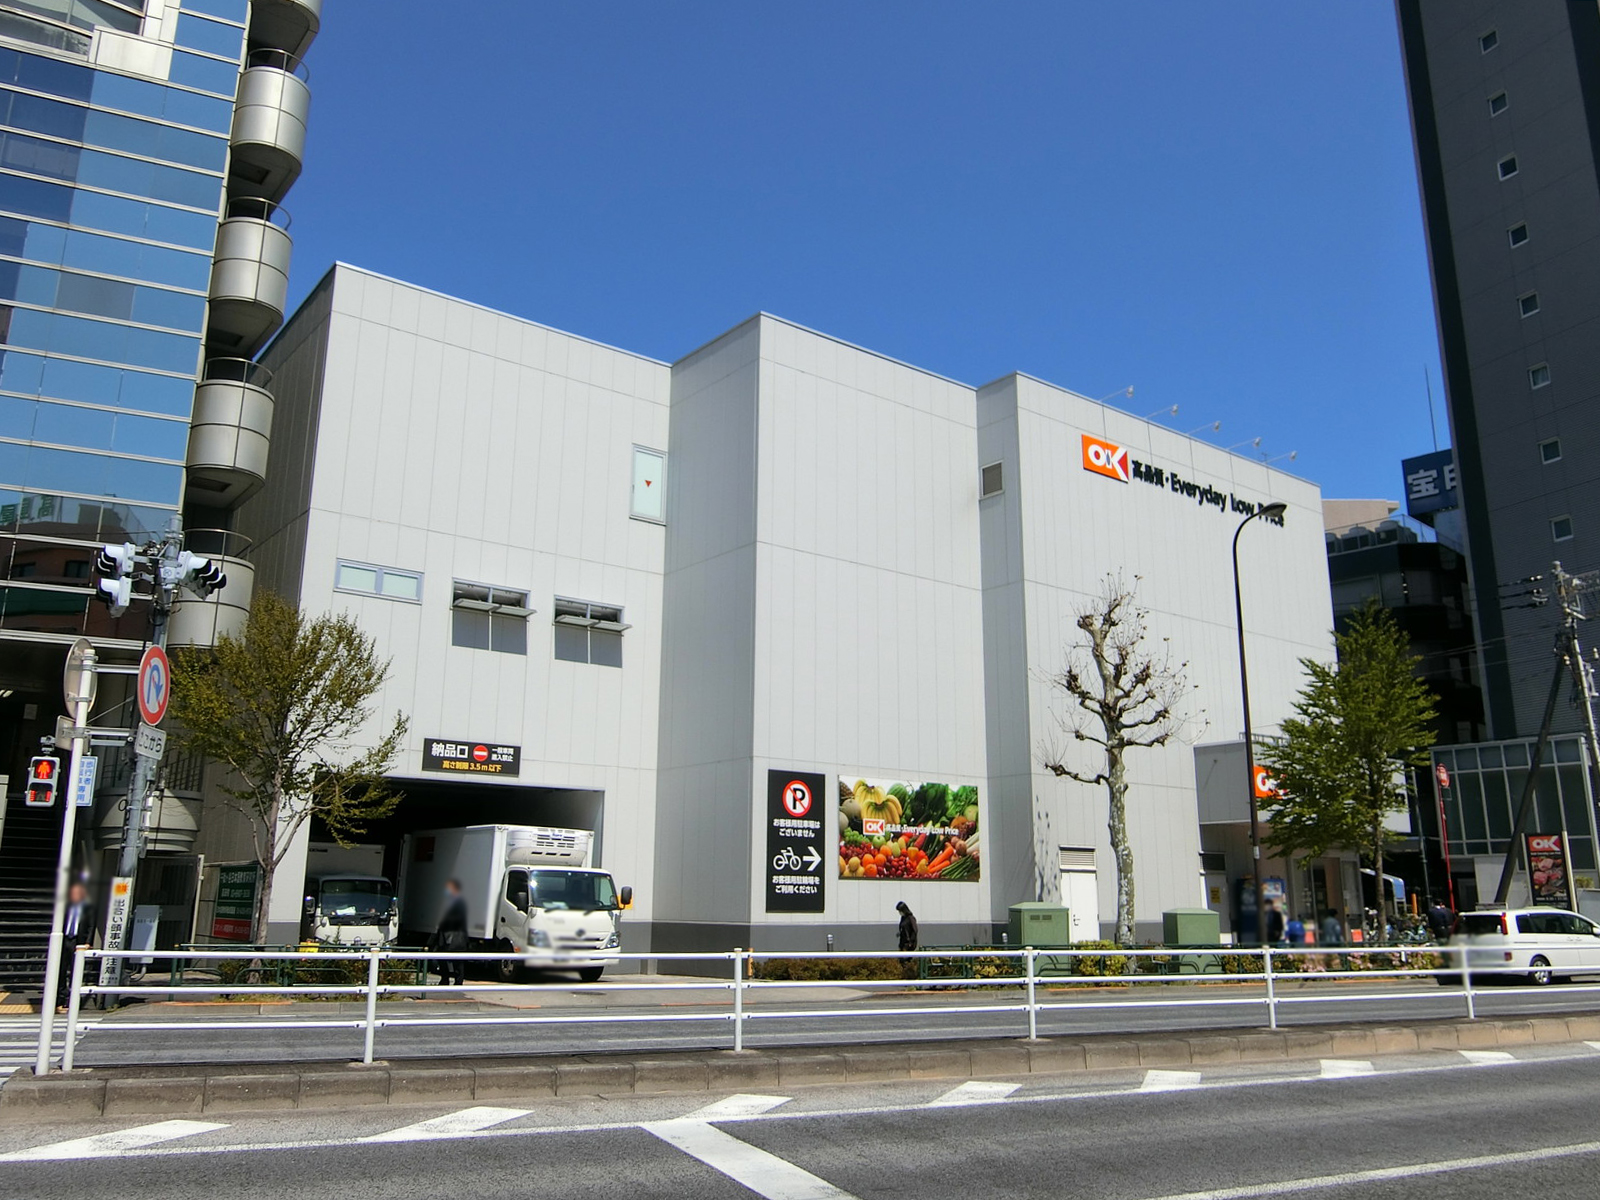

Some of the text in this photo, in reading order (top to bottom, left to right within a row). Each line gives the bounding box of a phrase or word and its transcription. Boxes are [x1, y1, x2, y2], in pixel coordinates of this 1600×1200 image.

[1088, 444, 1129, 482] OK
[1231, 493, 1255, 517] Low
[138, 731, 162, 753] ここから
[431, 742, 469, 759] 納品口
[779, 828, 815, 838] ございません
[866, 820, 883, 834] OK
[945, 826, 959, 836] Price
[1532, 835, 1561, 852] OK
[775, 884, 818, 894] ご利用ください
